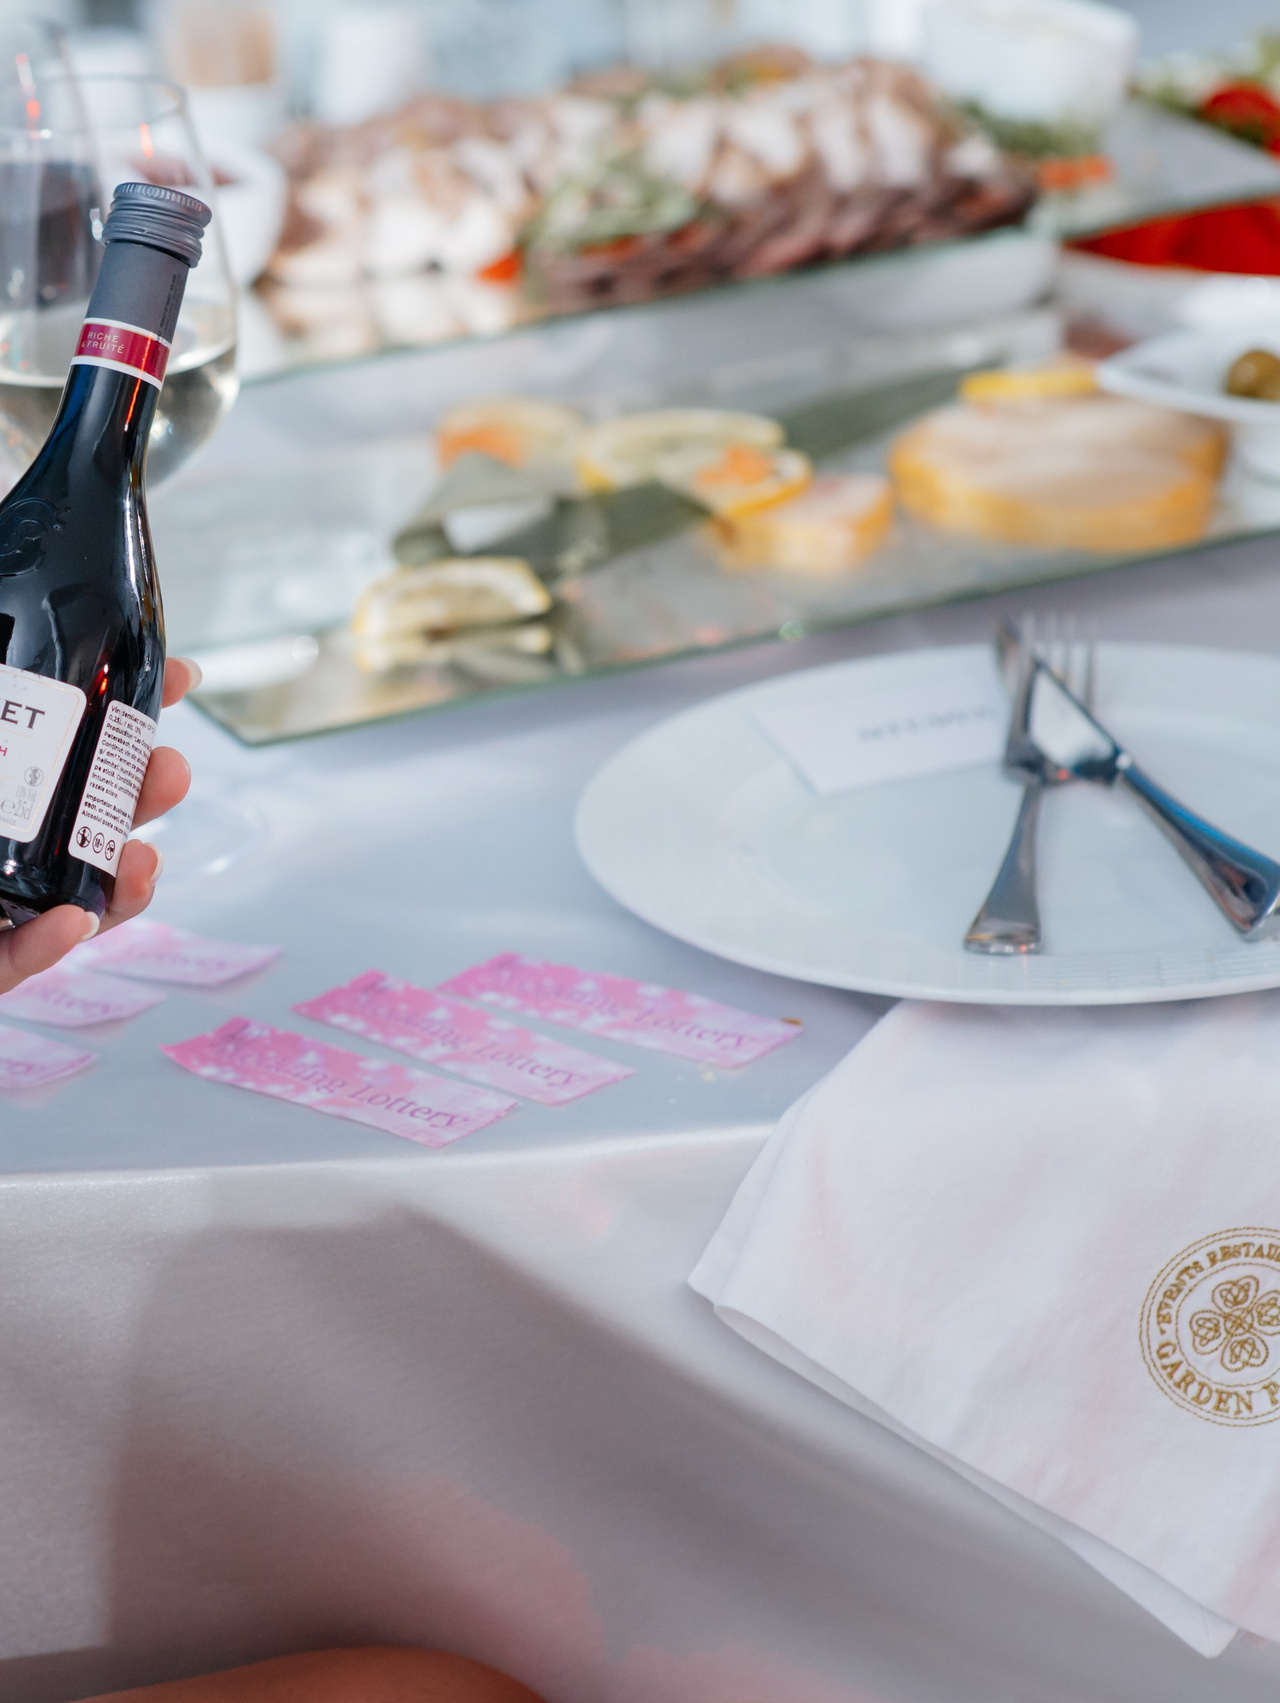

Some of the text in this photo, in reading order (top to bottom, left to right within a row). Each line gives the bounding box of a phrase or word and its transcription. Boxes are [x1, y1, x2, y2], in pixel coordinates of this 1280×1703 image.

[87, 331, 119, 343] RICHE
[87, 340, 124, 354] FRUITÉ
[349, 1083, 469, 1129] Lottery
[1206, 1242, 1280, 1268] RESTAU
[1156, 1342, 1254, 1416] GARDEN
